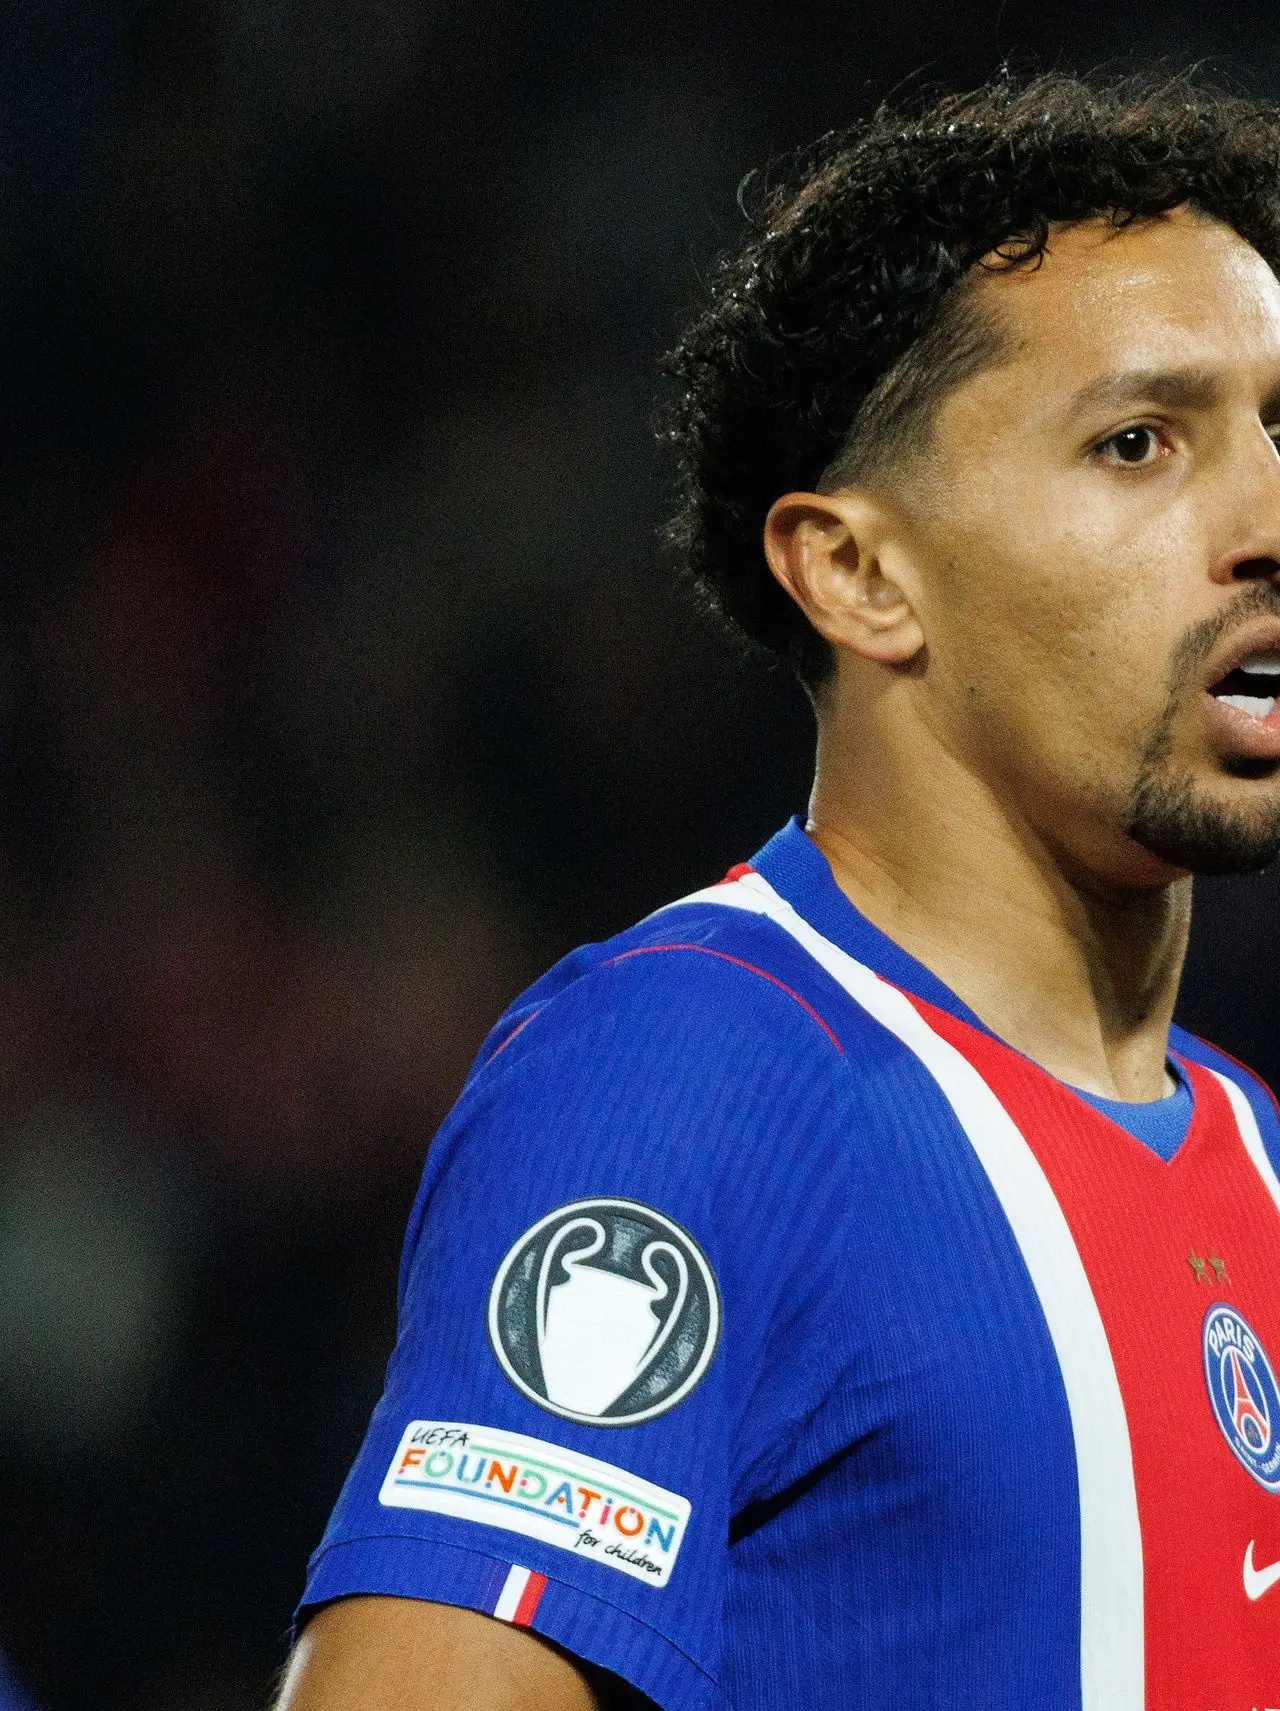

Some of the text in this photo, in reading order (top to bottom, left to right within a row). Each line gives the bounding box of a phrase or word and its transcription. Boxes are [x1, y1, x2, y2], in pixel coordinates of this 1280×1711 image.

[1208, 1316, 1255, 1363] PARIS
[409, 1426, 470, 1448] UEFA
[397, 1447, 676, 1554] FOUNDATION
[573, 1528, 663, 1576] for children
